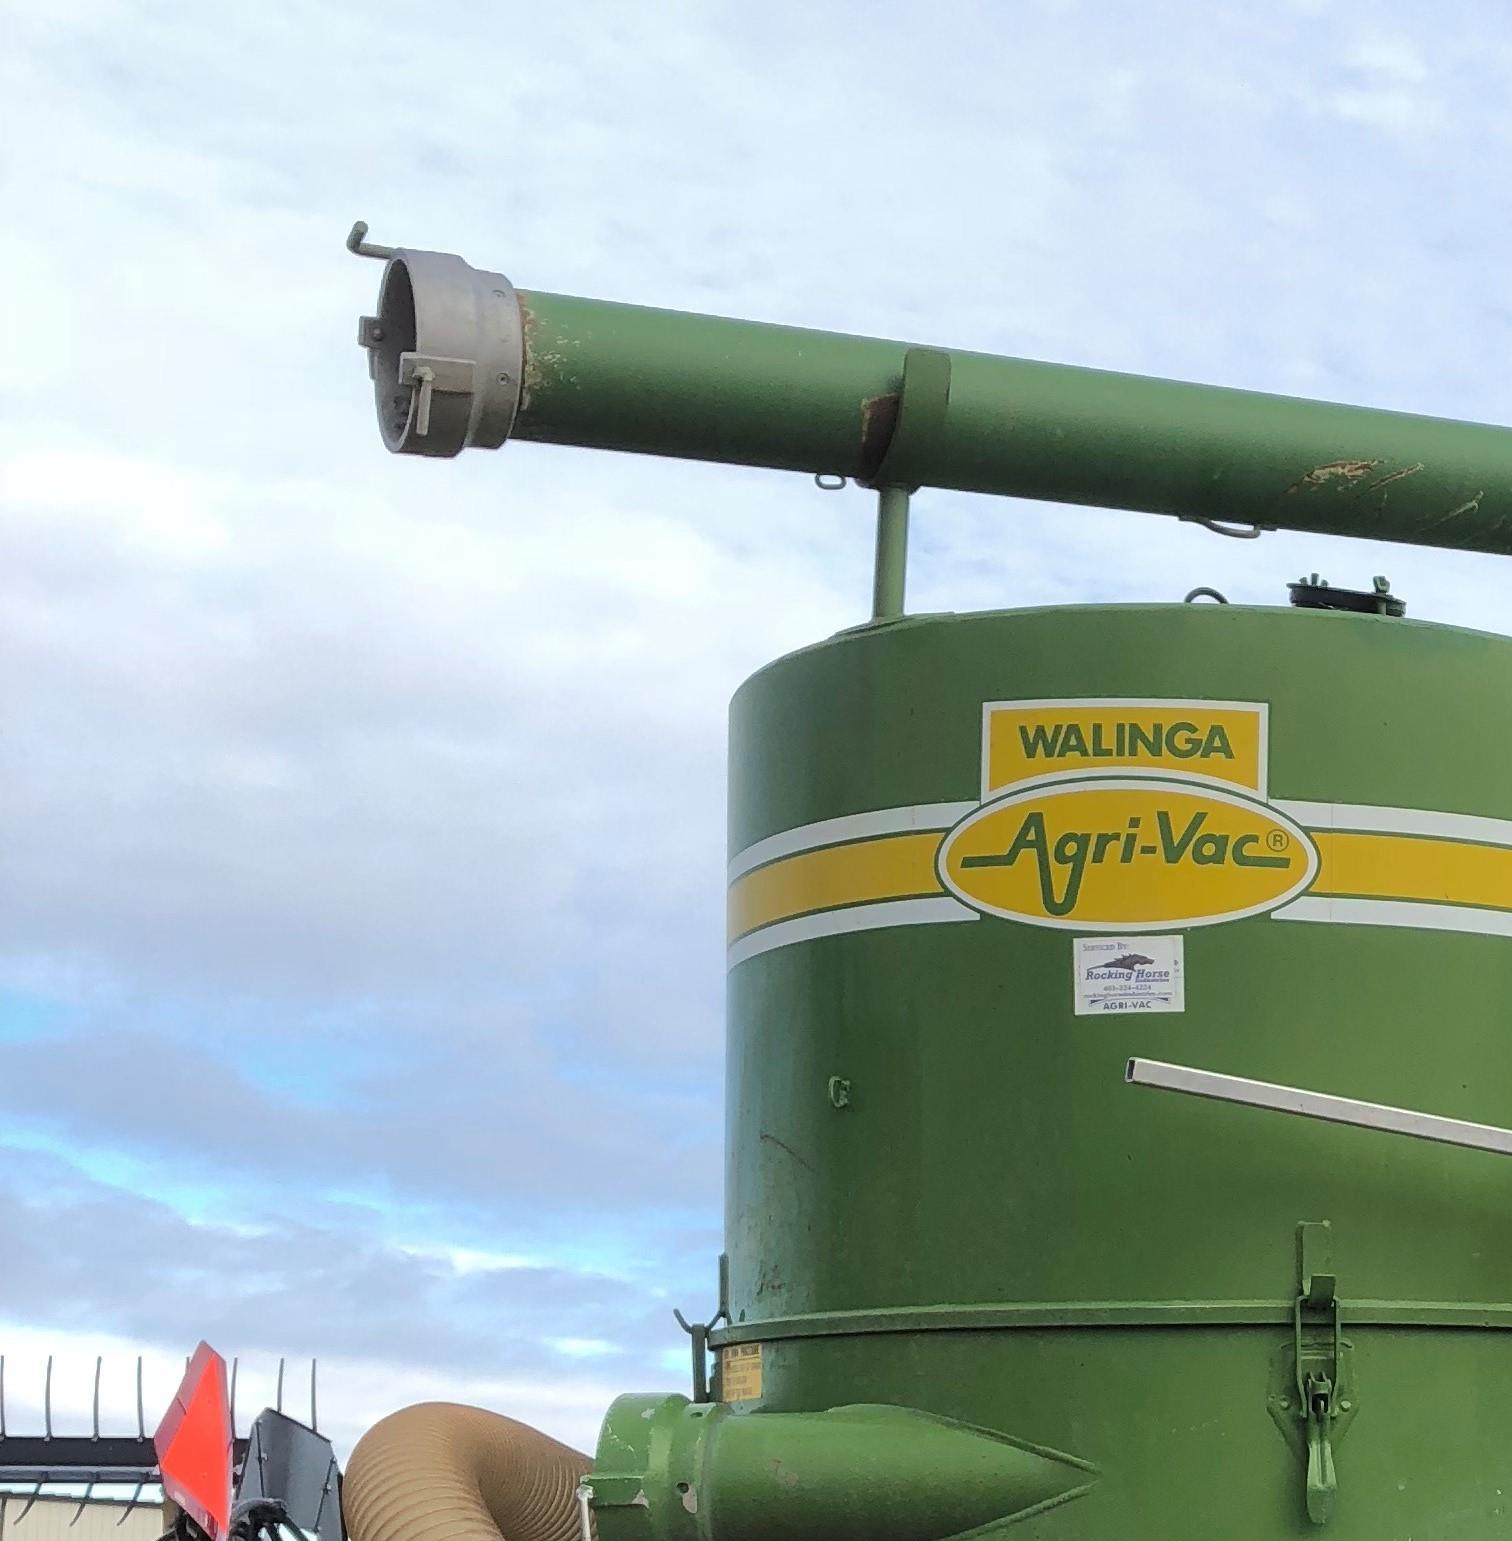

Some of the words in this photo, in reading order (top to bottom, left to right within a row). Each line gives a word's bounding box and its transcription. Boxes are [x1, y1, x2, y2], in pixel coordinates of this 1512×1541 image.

[1018, 722, 1235, 759] WALINGA
[1086, 970, 1133, 981] Rocking
[1136, 969, 1170, 979] Horse
[1103, 1001, 1152, 1010] AGRI-VAC
